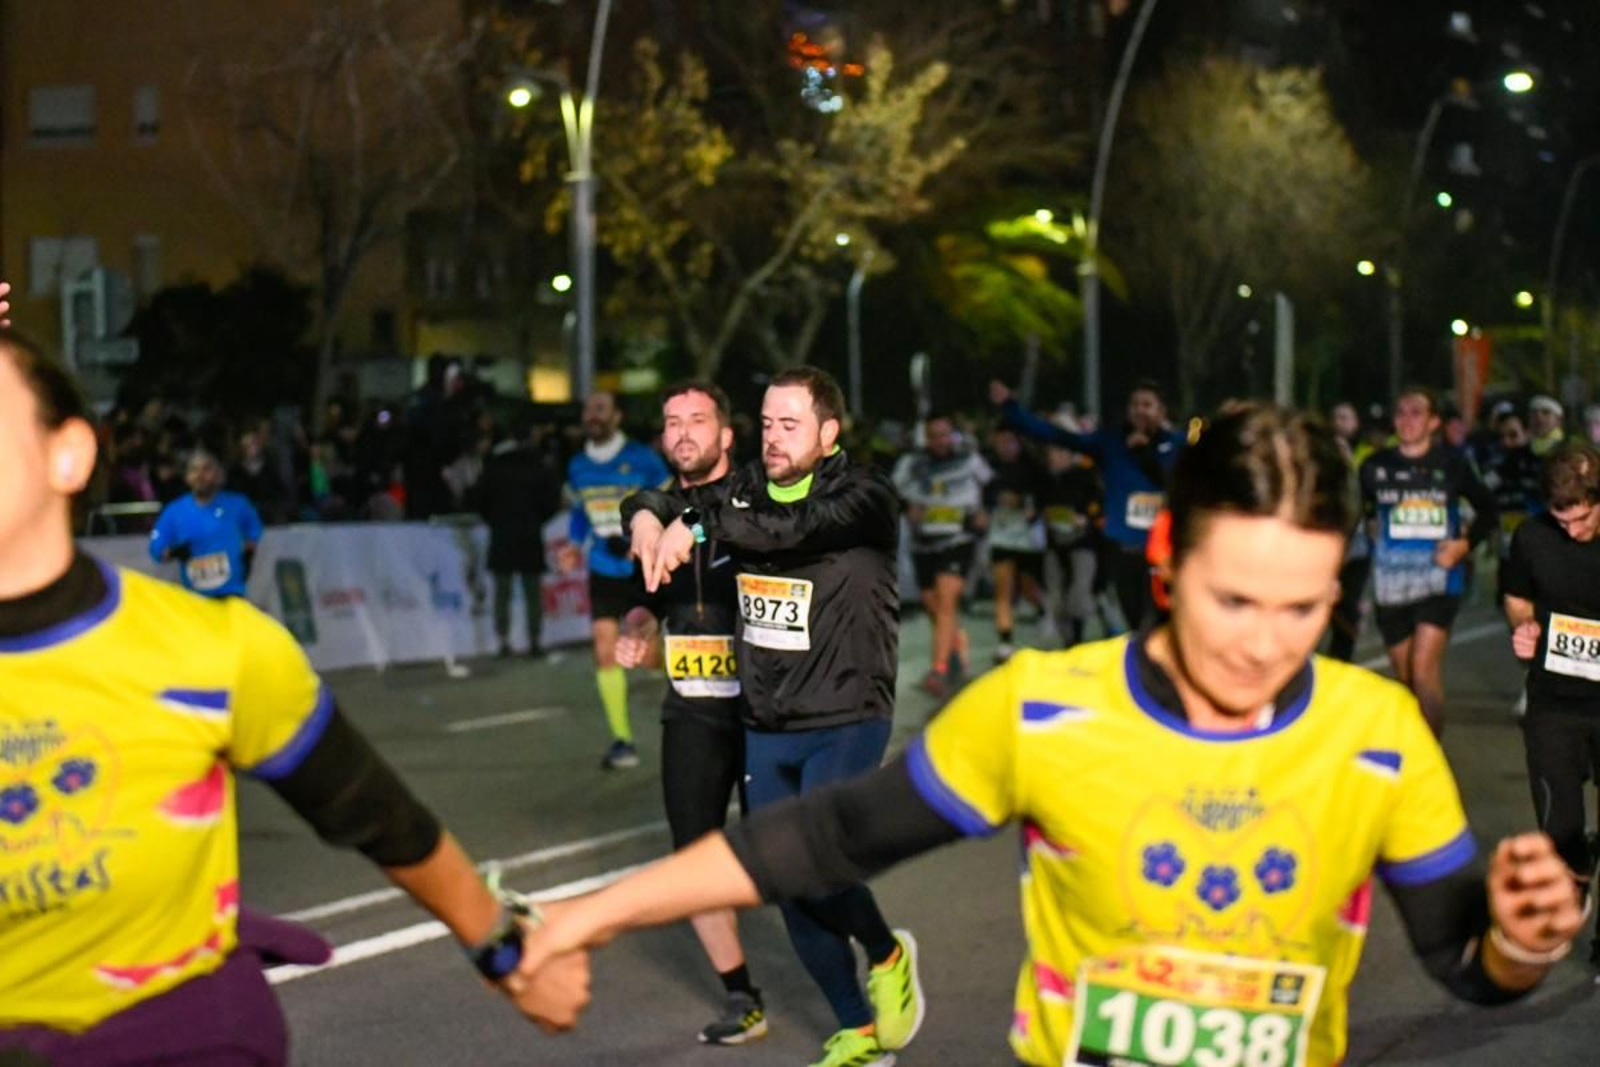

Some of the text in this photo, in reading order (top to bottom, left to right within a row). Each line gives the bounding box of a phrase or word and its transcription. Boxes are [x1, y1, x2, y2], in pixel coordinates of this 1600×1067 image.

[743, 595, 799, 623] 8973
[675, 655, 737, 676] 4120
[1097, 990, 1293, 1067] 1038
